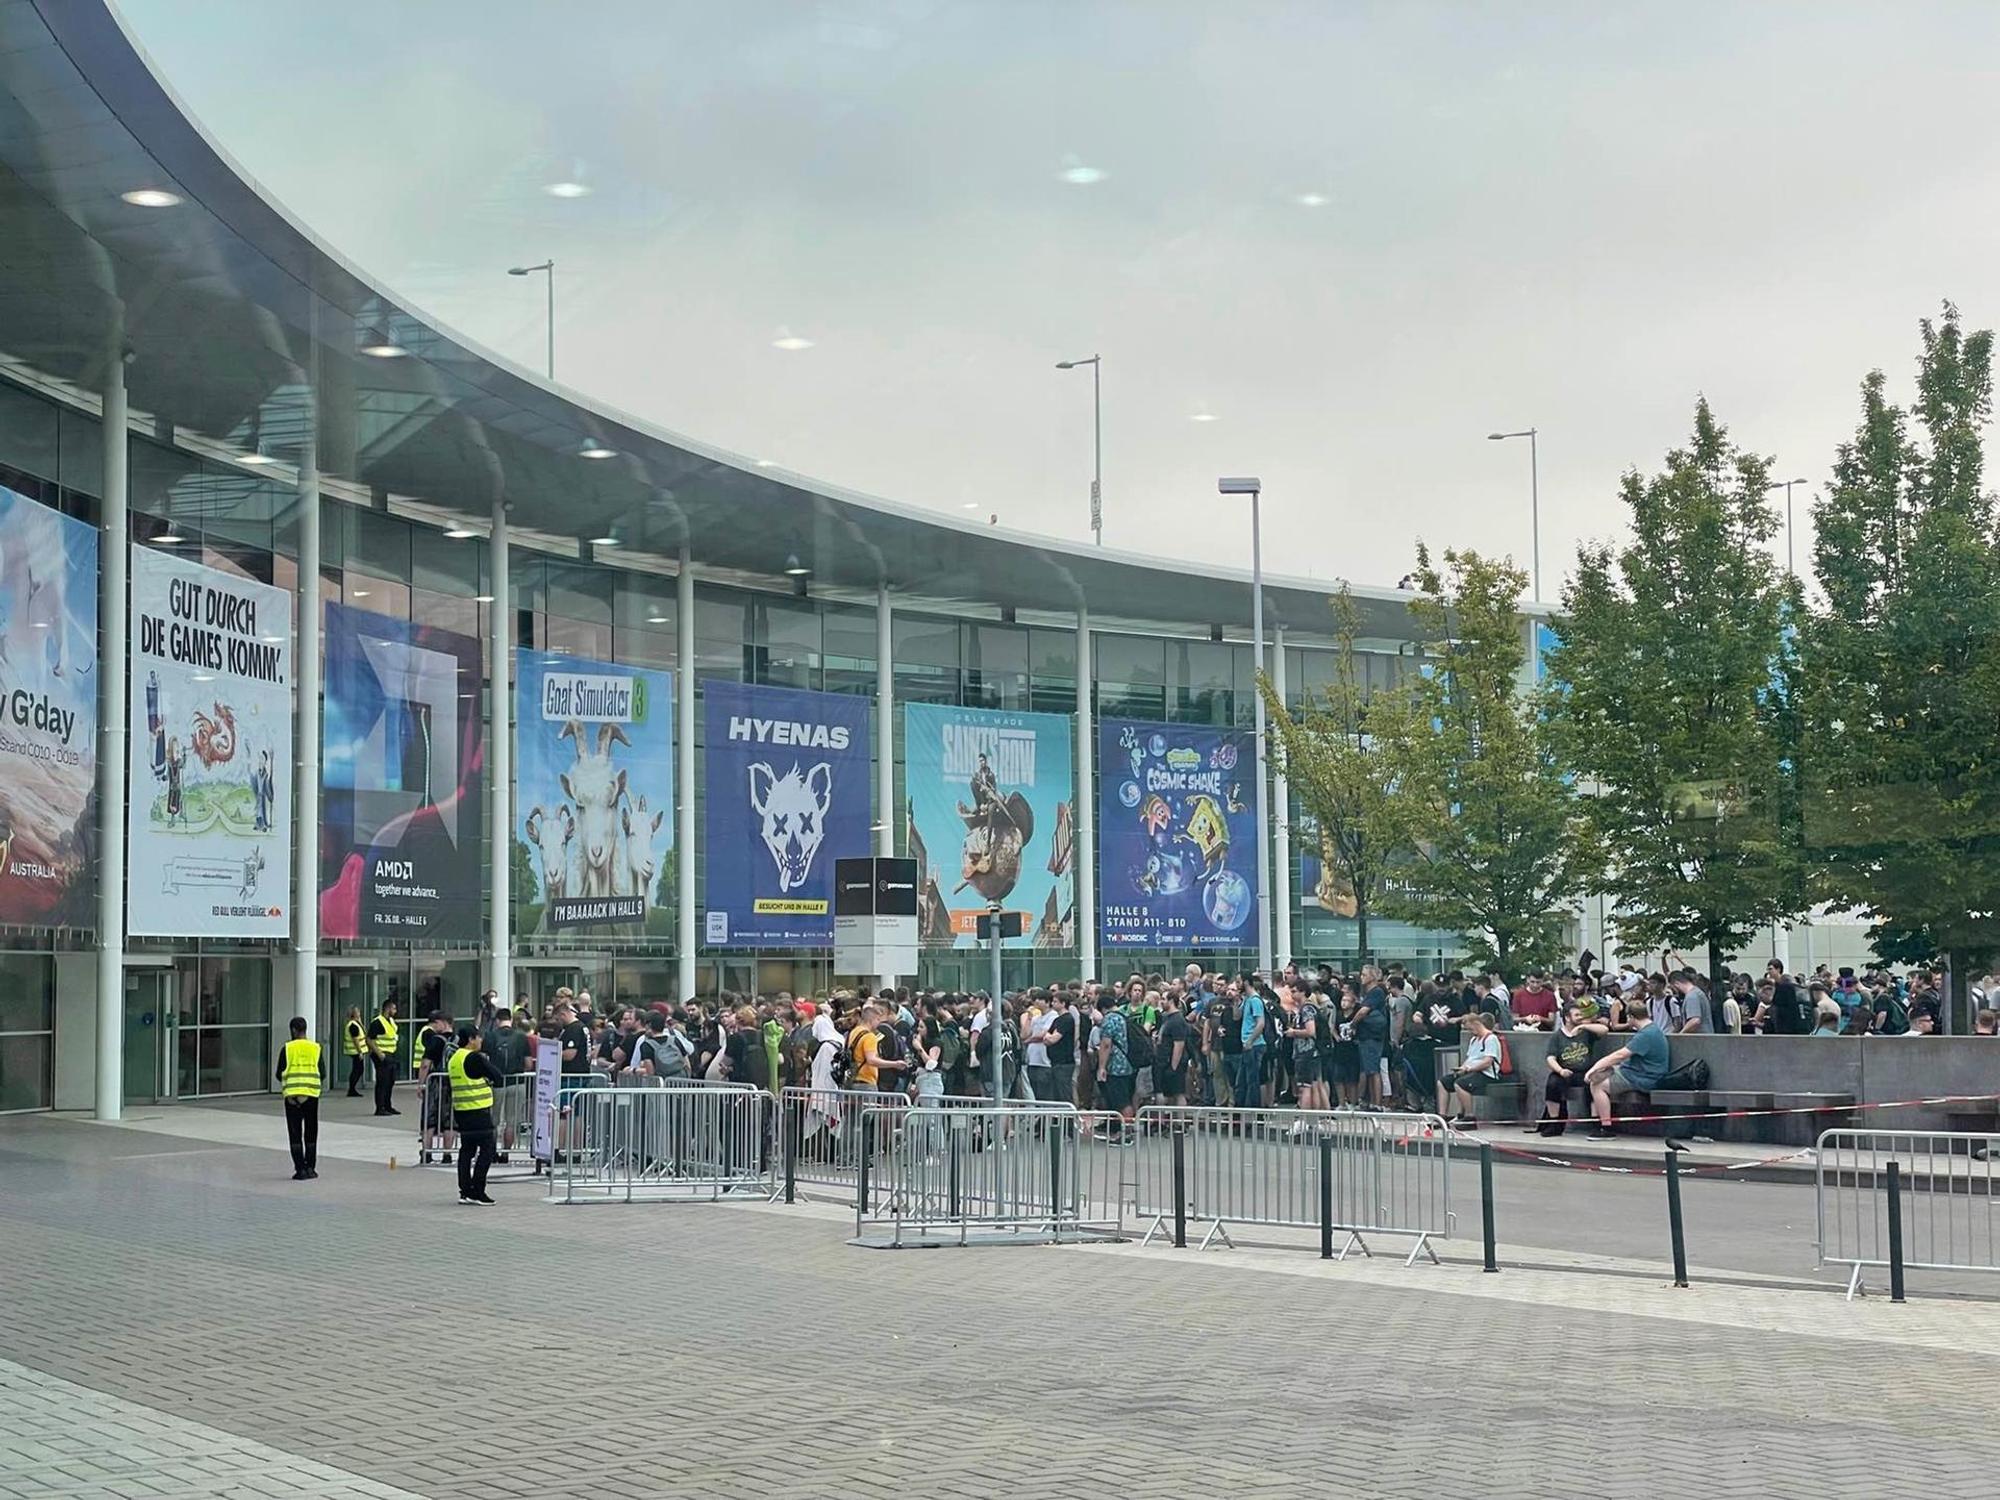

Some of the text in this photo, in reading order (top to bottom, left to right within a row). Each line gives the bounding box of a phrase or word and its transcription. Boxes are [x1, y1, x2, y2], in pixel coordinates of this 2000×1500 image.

[170, 578, 256, 637] GUT DURCH
[141, 614, 165, 657] DIE
[170, 622, 222, 671] GAMES
[547, 678, 572, 716] Goat
[636, 683, 643, 717] 3
[993, 717, 1023, 726] MADE
[729, 716, 850, 750] HYENAS
[1147, 767, 1186, 792] COSMIC
[1188, 771, 1221, 795] SHAKE
[10, 862, 56, 878] AUSTRALIA
[375, 860, 403, 878] AMD
[609, 902, 617, 917] IN
[618, 901, 636, 916] HALL
[637, 900, 643, 915] 9
[1106, 906, 1138, 916] HALLE
[1106, 917, 1143, 927] STAND
[1168, 918, 1186, 928] B10
